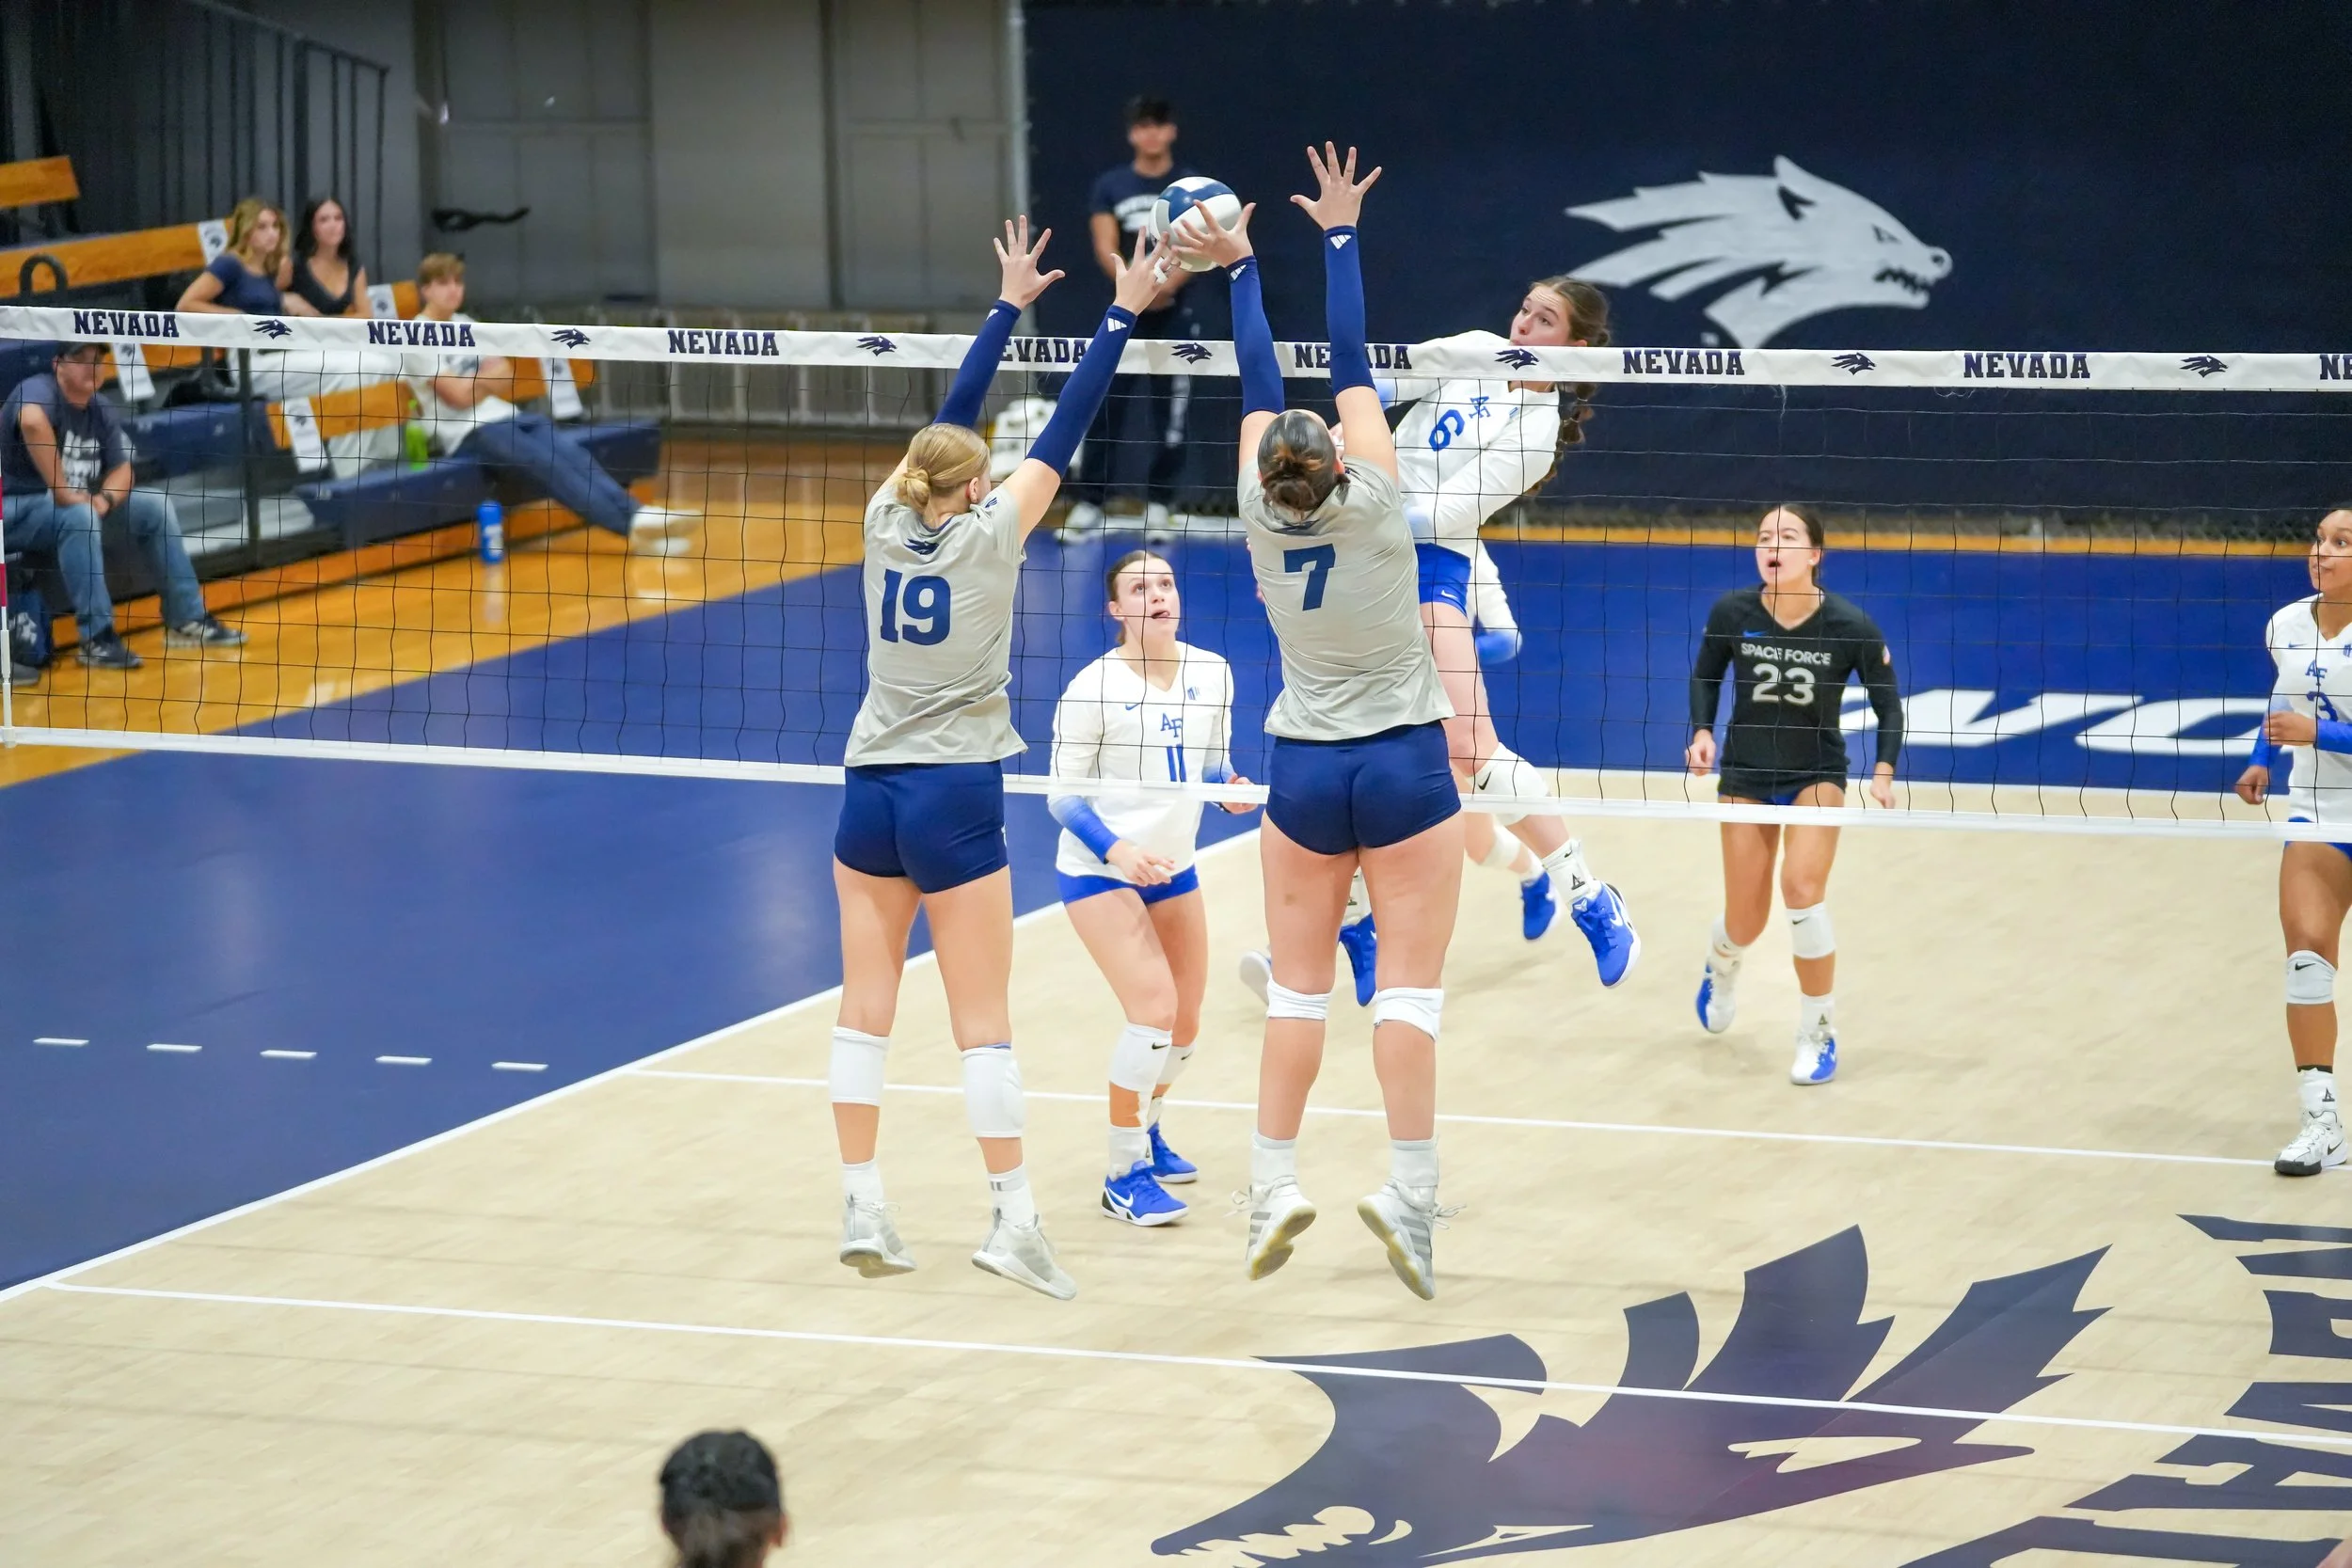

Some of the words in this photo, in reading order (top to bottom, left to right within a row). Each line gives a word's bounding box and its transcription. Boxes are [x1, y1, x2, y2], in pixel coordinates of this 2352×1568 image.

[73, 310, 179, 338] NEVADA
[367, 321, 476, 347] NEVADA
[667, 329, 780, 356] NEVADA
[1000, 338, 1088, 364] EVADA
[1623, 349, 1745, 375] NEVADA
[1963, 352, 2090, 379] NEVADA
[1428, 408, 1465, 451] 6
[1282, 543, 1336, 611] 7
[880, 568, 951, 646] 19
[1740, 642, 1782, 661] SPACE
[1784, 648, 1832, 666] FORCE
[1752, 662, 1816, 705] 23
